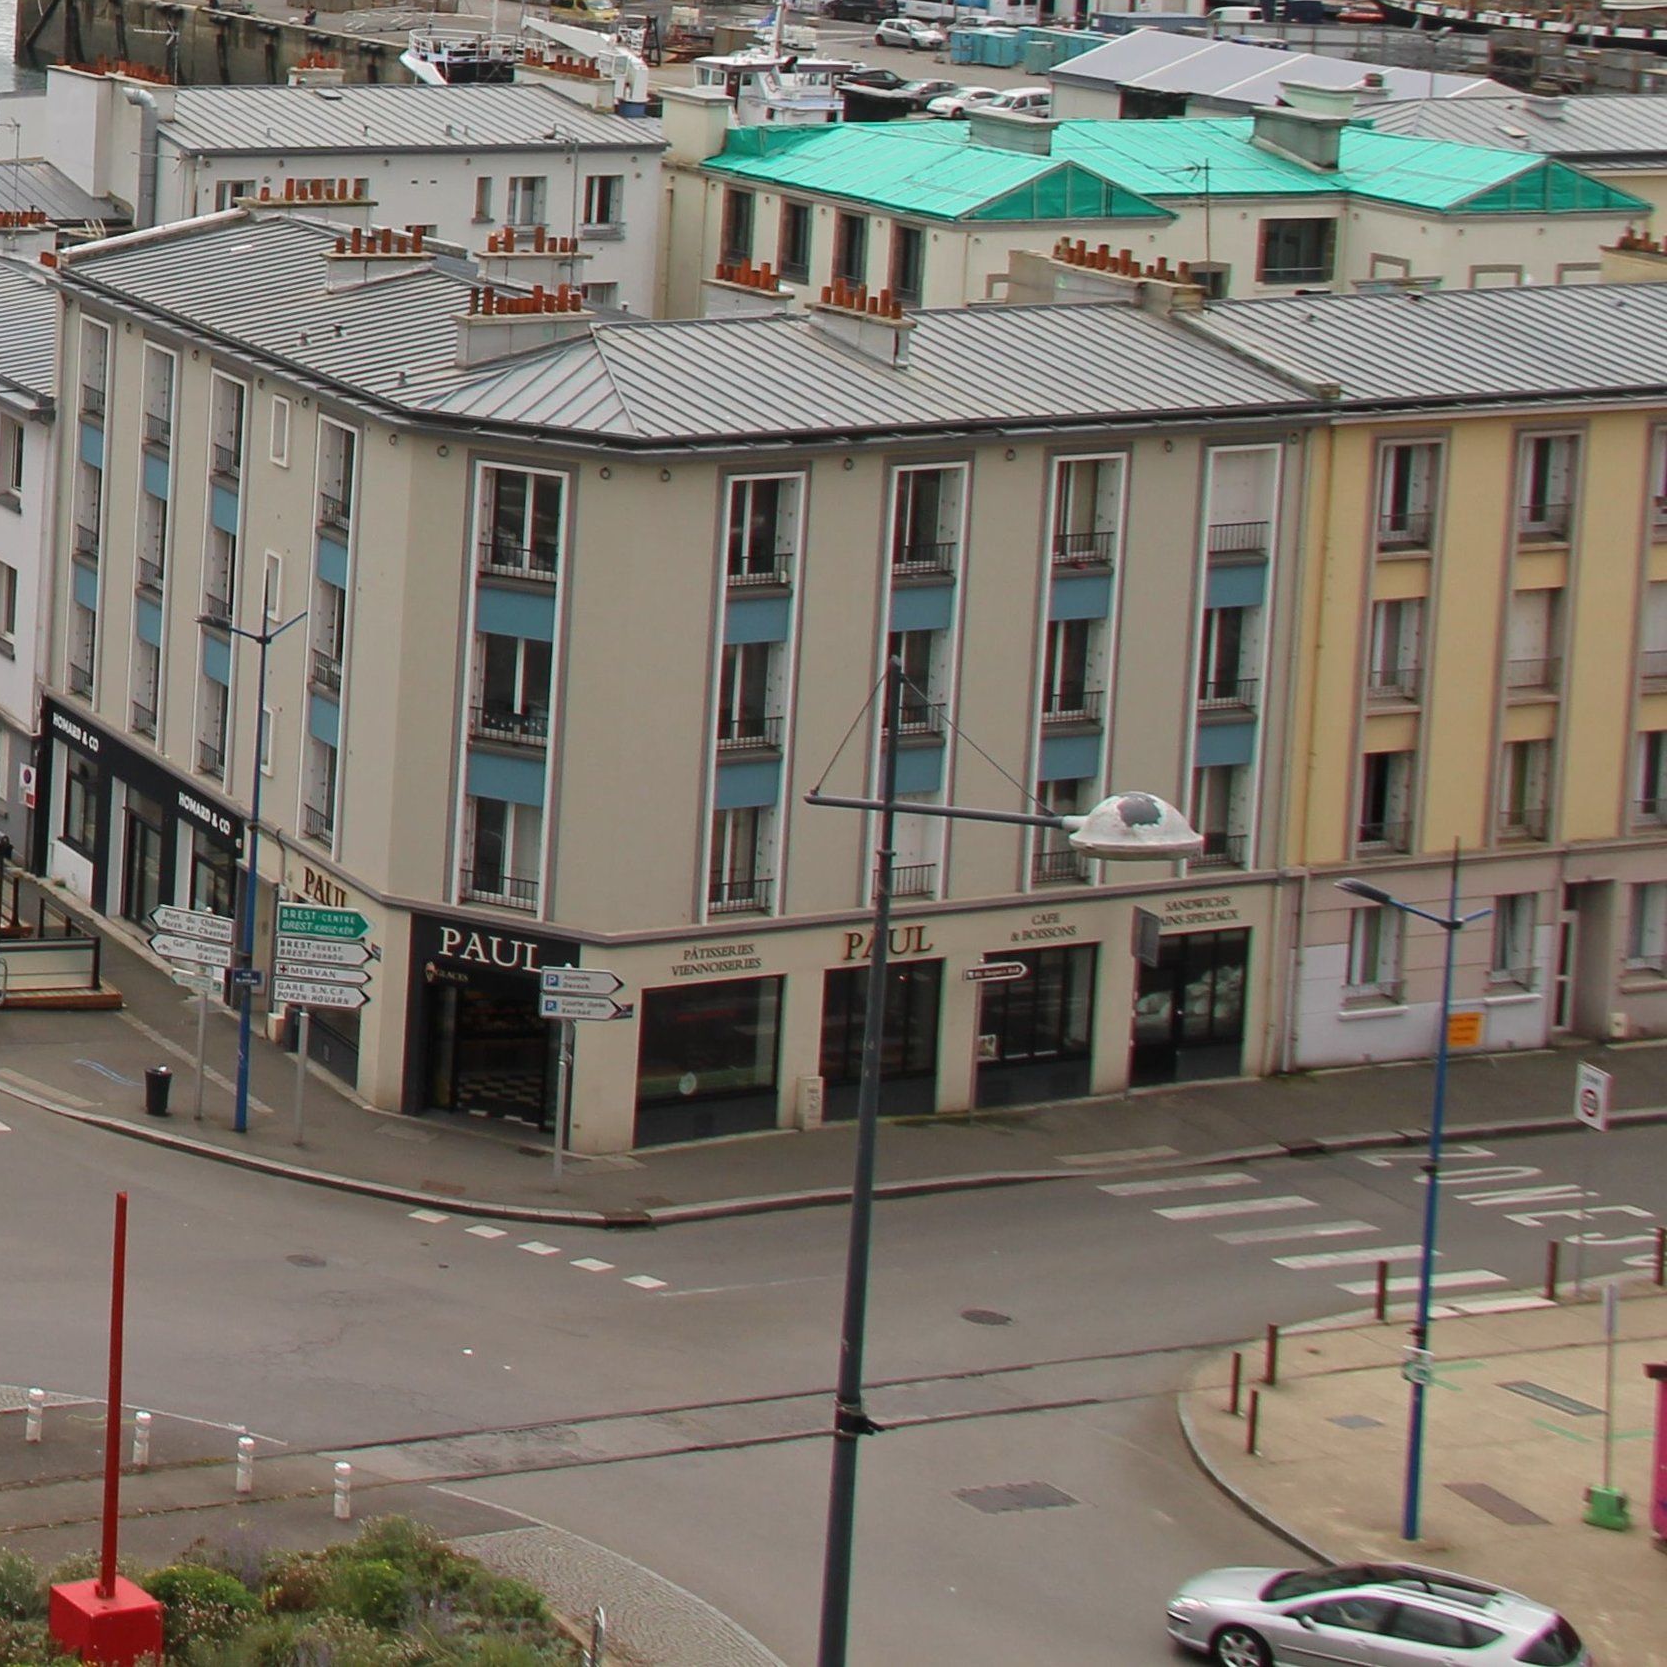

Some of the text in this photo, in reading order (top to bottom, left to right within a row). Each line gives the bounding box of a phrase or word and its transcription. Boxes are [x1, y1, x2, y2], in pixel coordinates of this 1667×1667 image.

[178, 791, 211, 826] HOMARD
[211, 812, 218, 828] &
[843, 925, 934, 961] PUL
[1021, 926, 1077, 941] BOISSONS
[438, 926, 542, 973] PAUL
[683, 943, 755, 961] PÂTISSERIES
[290, 966, 337, 979] MORVAN
[671, 957, 762, 977] VIENNOISERIES
[277, 981, 305, 992] GARE
